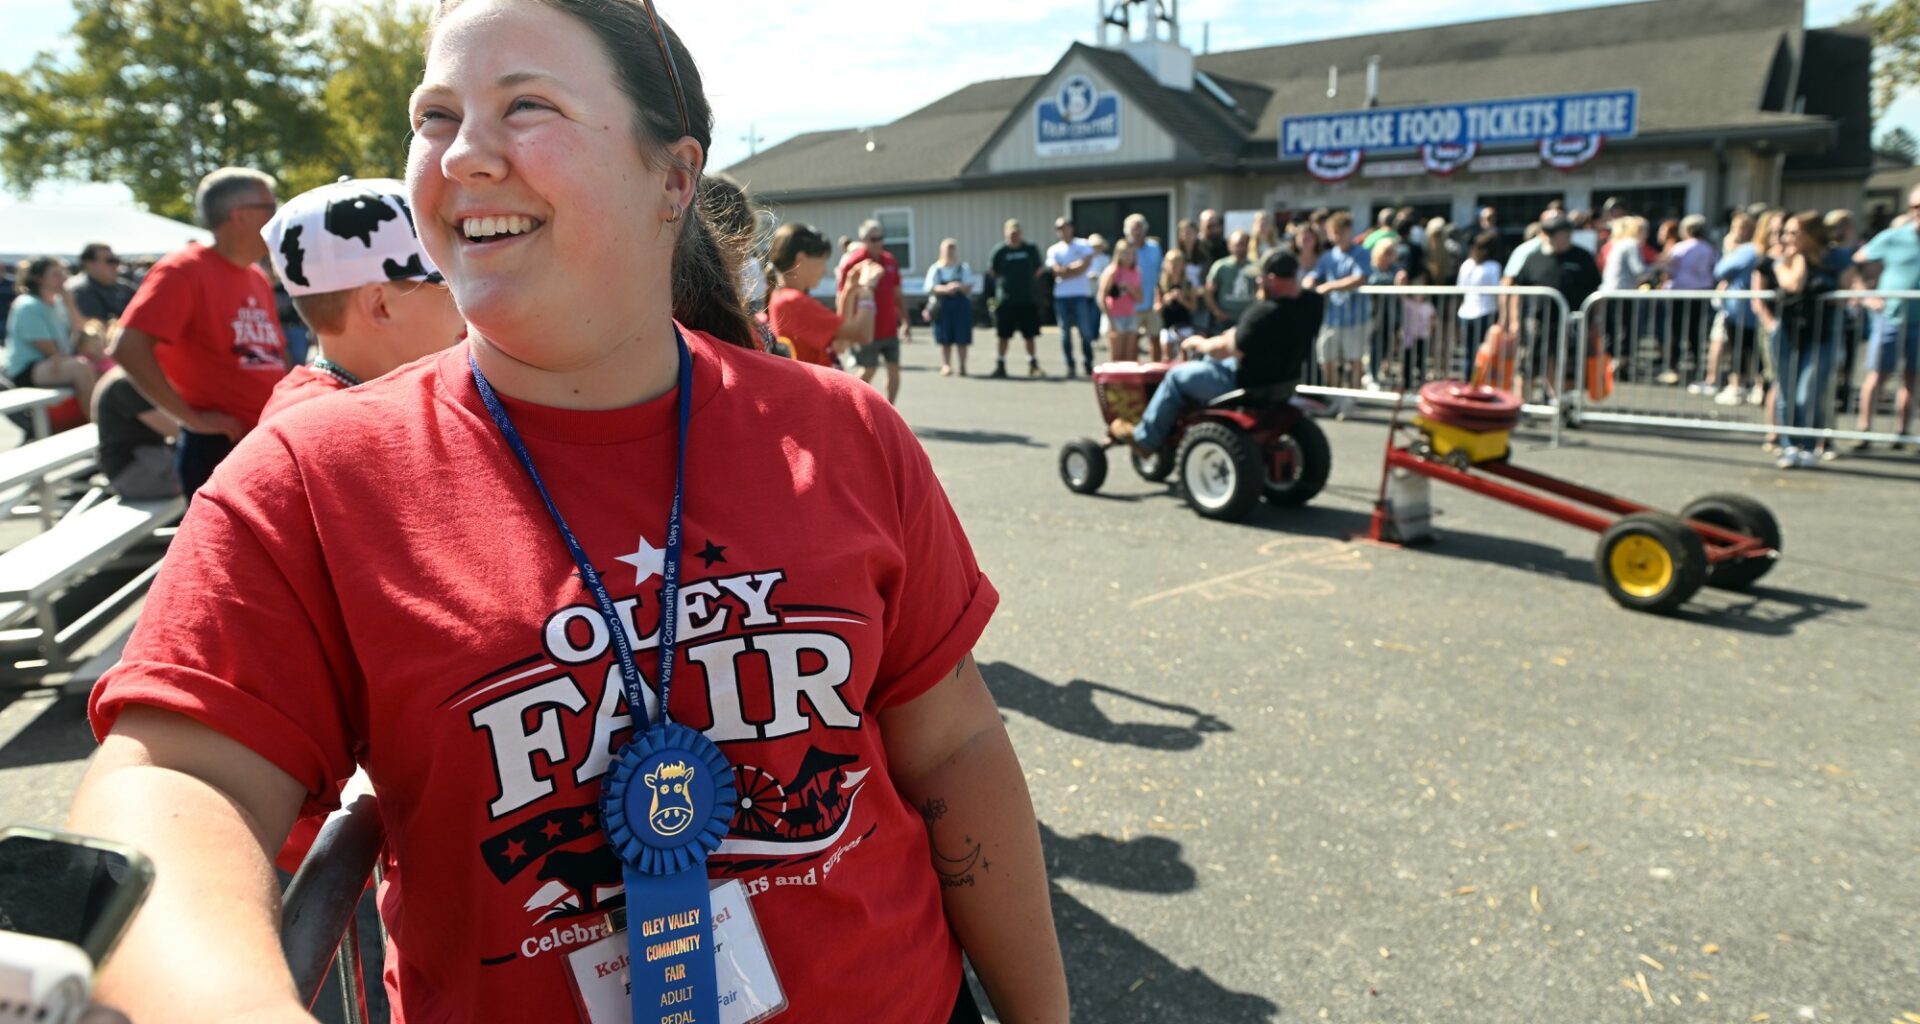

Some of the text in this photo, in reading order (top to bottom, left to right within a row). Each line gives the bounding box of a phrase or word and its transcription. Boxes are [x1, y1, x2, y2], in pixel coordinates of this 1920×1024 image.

[1286, 95, 1629, 152] PURCHASE FOOD TICKETS HERE
[231, 319, 279, 346] FAIR
[667, 524, 680, 546] Oley
[665, 560, 676, 580] Fair
[543, 569, 786, 664] OLEY
[663, 582, 677, 646] Community
[584, 563, 641, 707] Oley Valley Community Fair
[662, 648, 675, 684] Valley
[469, 630, 861, 819] FAIR
[775, 867, 817, 885] and
[642, 908, 700, 937] OLEY VALLEY
[646, 934, 700, 962] COMMUNITY
[664, 963, 686, 983] FAIR
[660, 985, 694, 1007] ADULT
[661, 1009, 696, 1024] PEDAL
